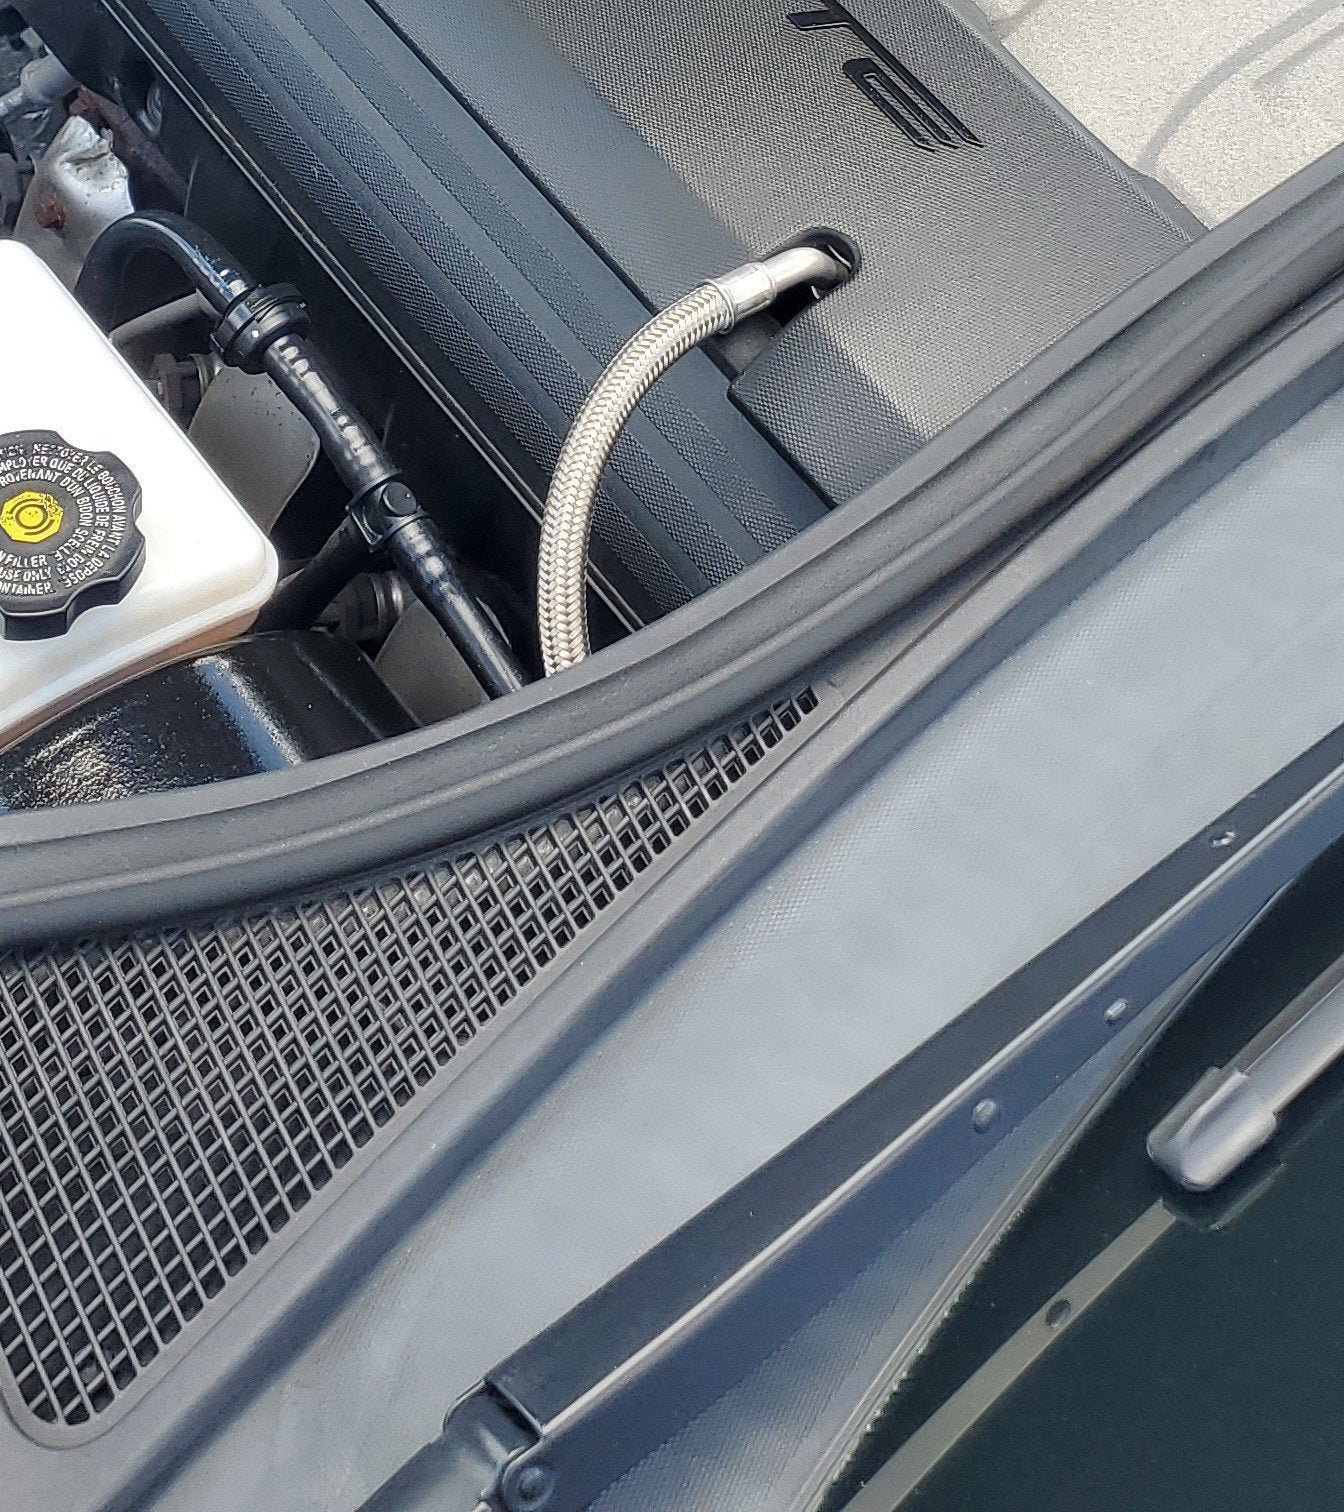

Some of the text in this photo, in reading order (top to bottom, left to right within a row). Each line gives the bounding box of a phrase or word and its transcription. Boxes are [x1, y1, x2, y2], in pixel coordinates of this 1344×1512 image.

[49, 457, 75, 474] QUE
[86, 460, 104, 475] LE
[71, 467, 90, 482] DU
[84, 478, 110, 514] LIQUIDE
[98, 470, 127, 512] BOUCHON
[59, 476, 85, 498] D'UN
[76, 496, 94, 527] BIDON
[95, 514, 110, 529] DE
[107, 513, 127, 546] AVANT
[80, 529, 106, 556] FREIN
[98, 544, 116, 559] LA
[4, 553, 48, 568] FILLER
[22, 566, 52, 582] ONLY
